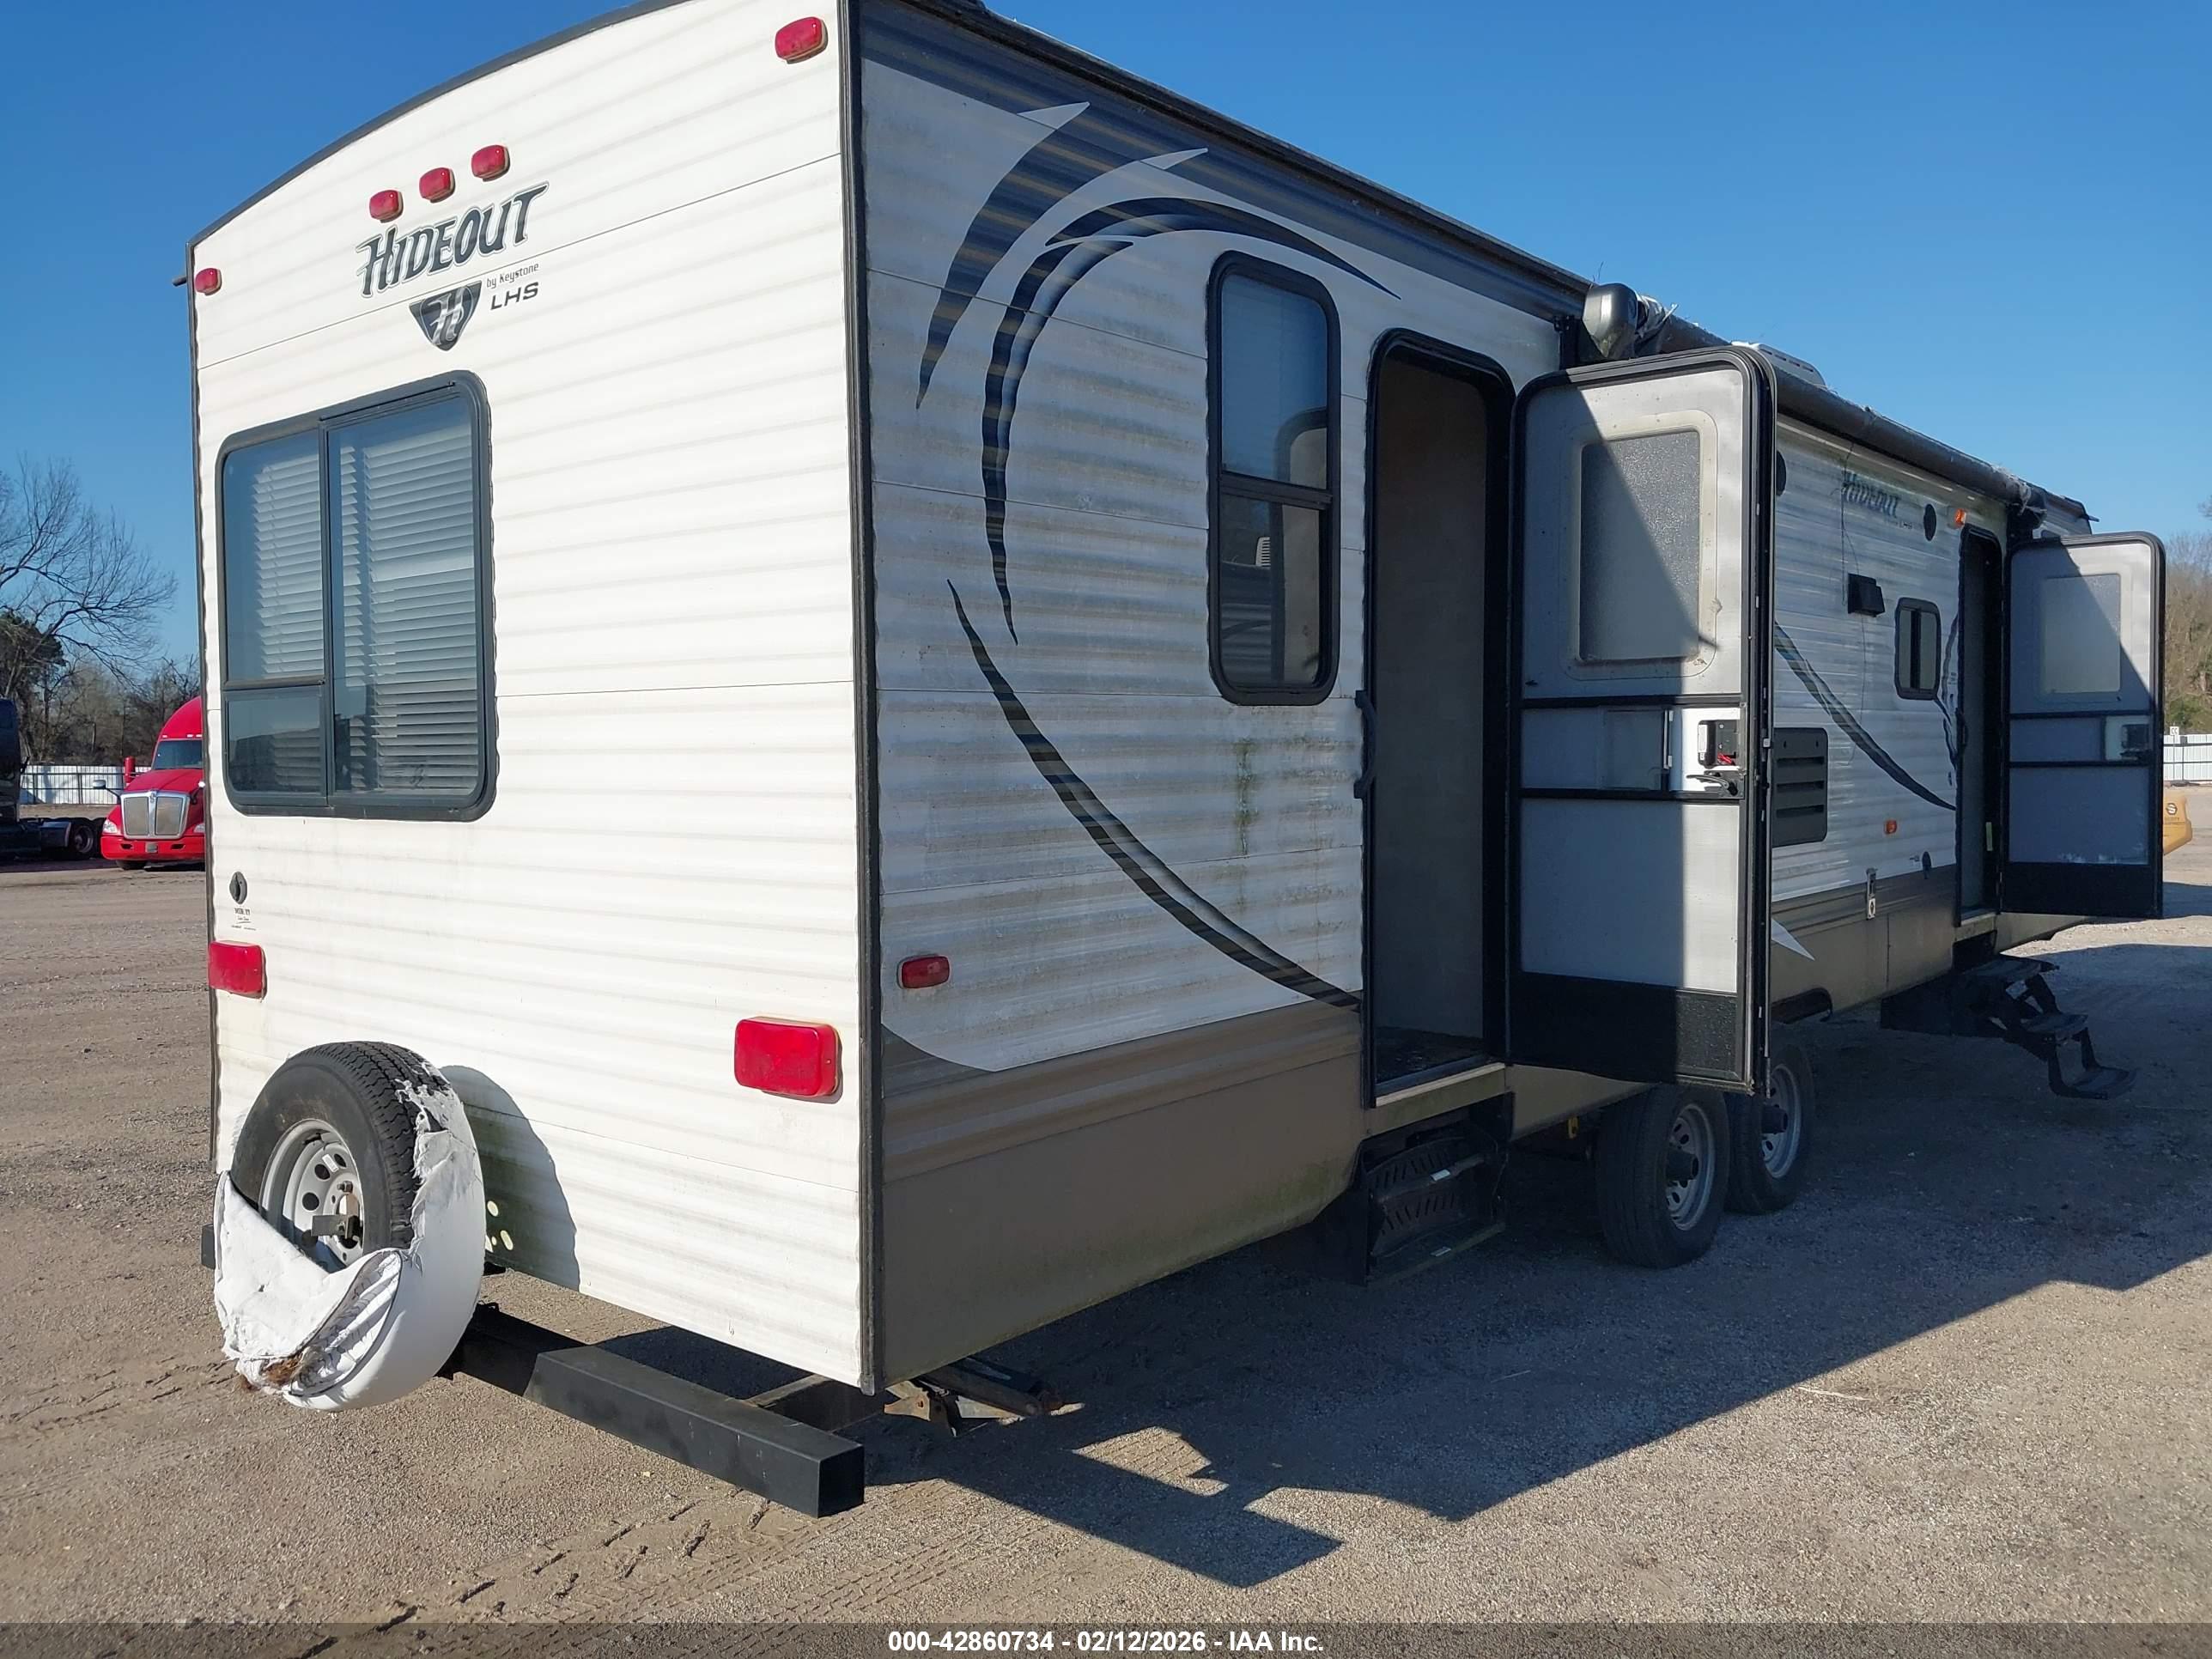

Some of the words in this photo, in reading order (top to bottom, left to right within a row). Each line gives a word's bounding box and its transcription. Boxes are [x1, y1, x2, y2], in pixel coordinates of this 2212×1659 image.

[357, 182, 549, 297] HIDEOUT
[486, 277, 497, 289] by
[490, 282, 539, 310] LHS
